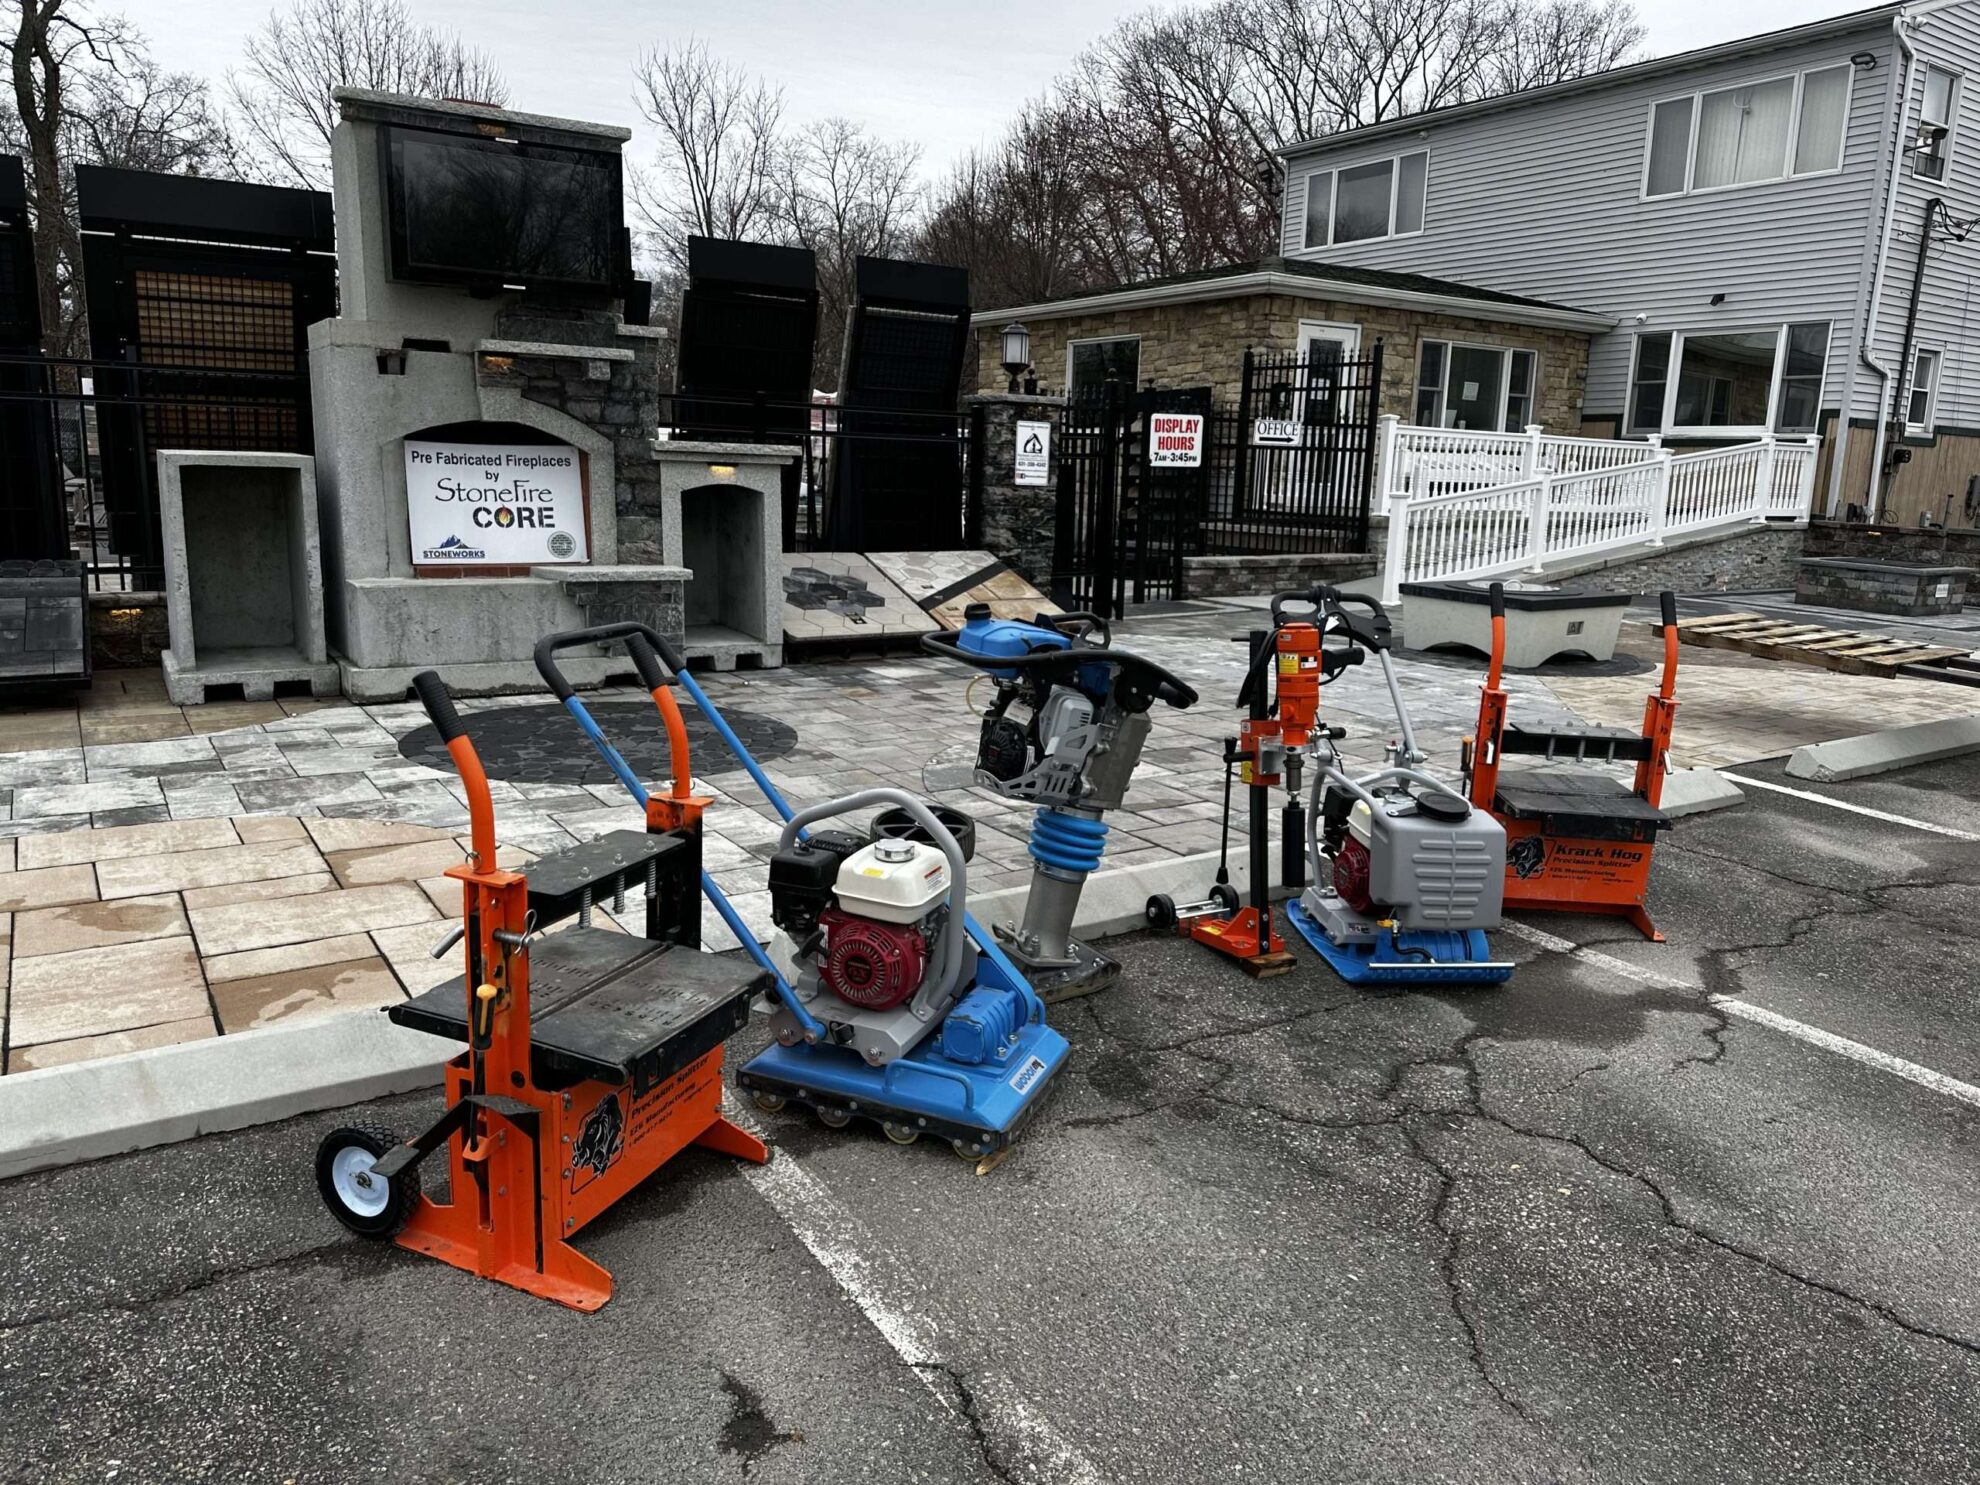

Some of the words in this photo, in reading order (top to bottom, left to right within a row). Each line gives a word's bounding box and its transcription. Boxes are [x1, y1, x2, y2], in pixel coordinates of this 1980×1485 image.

[1154, 418, 1200, 434] DISPLAY
[1257, 421, 1299, 436] OFFICE
[1158, 436, 1195, 451] HOURS
[411, 450, 432, 464] Pre
[436, 452, 502, 466] Fabricated
[506, 454, 571, 470] Fireplaces
[485, 470, 499, 482] by
[435, 478, 553, 503] StoneFire
[473, 506, 555, 529] CORE
[423, 550, 486, 559] STONEWORKS
[1555, 844, 1604, 858] Krack
[1610, 848, 1643, 862] Hog
[1552, 857, 1596, 866] Precision
[1598, 860, 1632, 868] Splitter
[632, 1082, 674, 1119] Precision
[676, 1056, 709, 1083] Splitter
